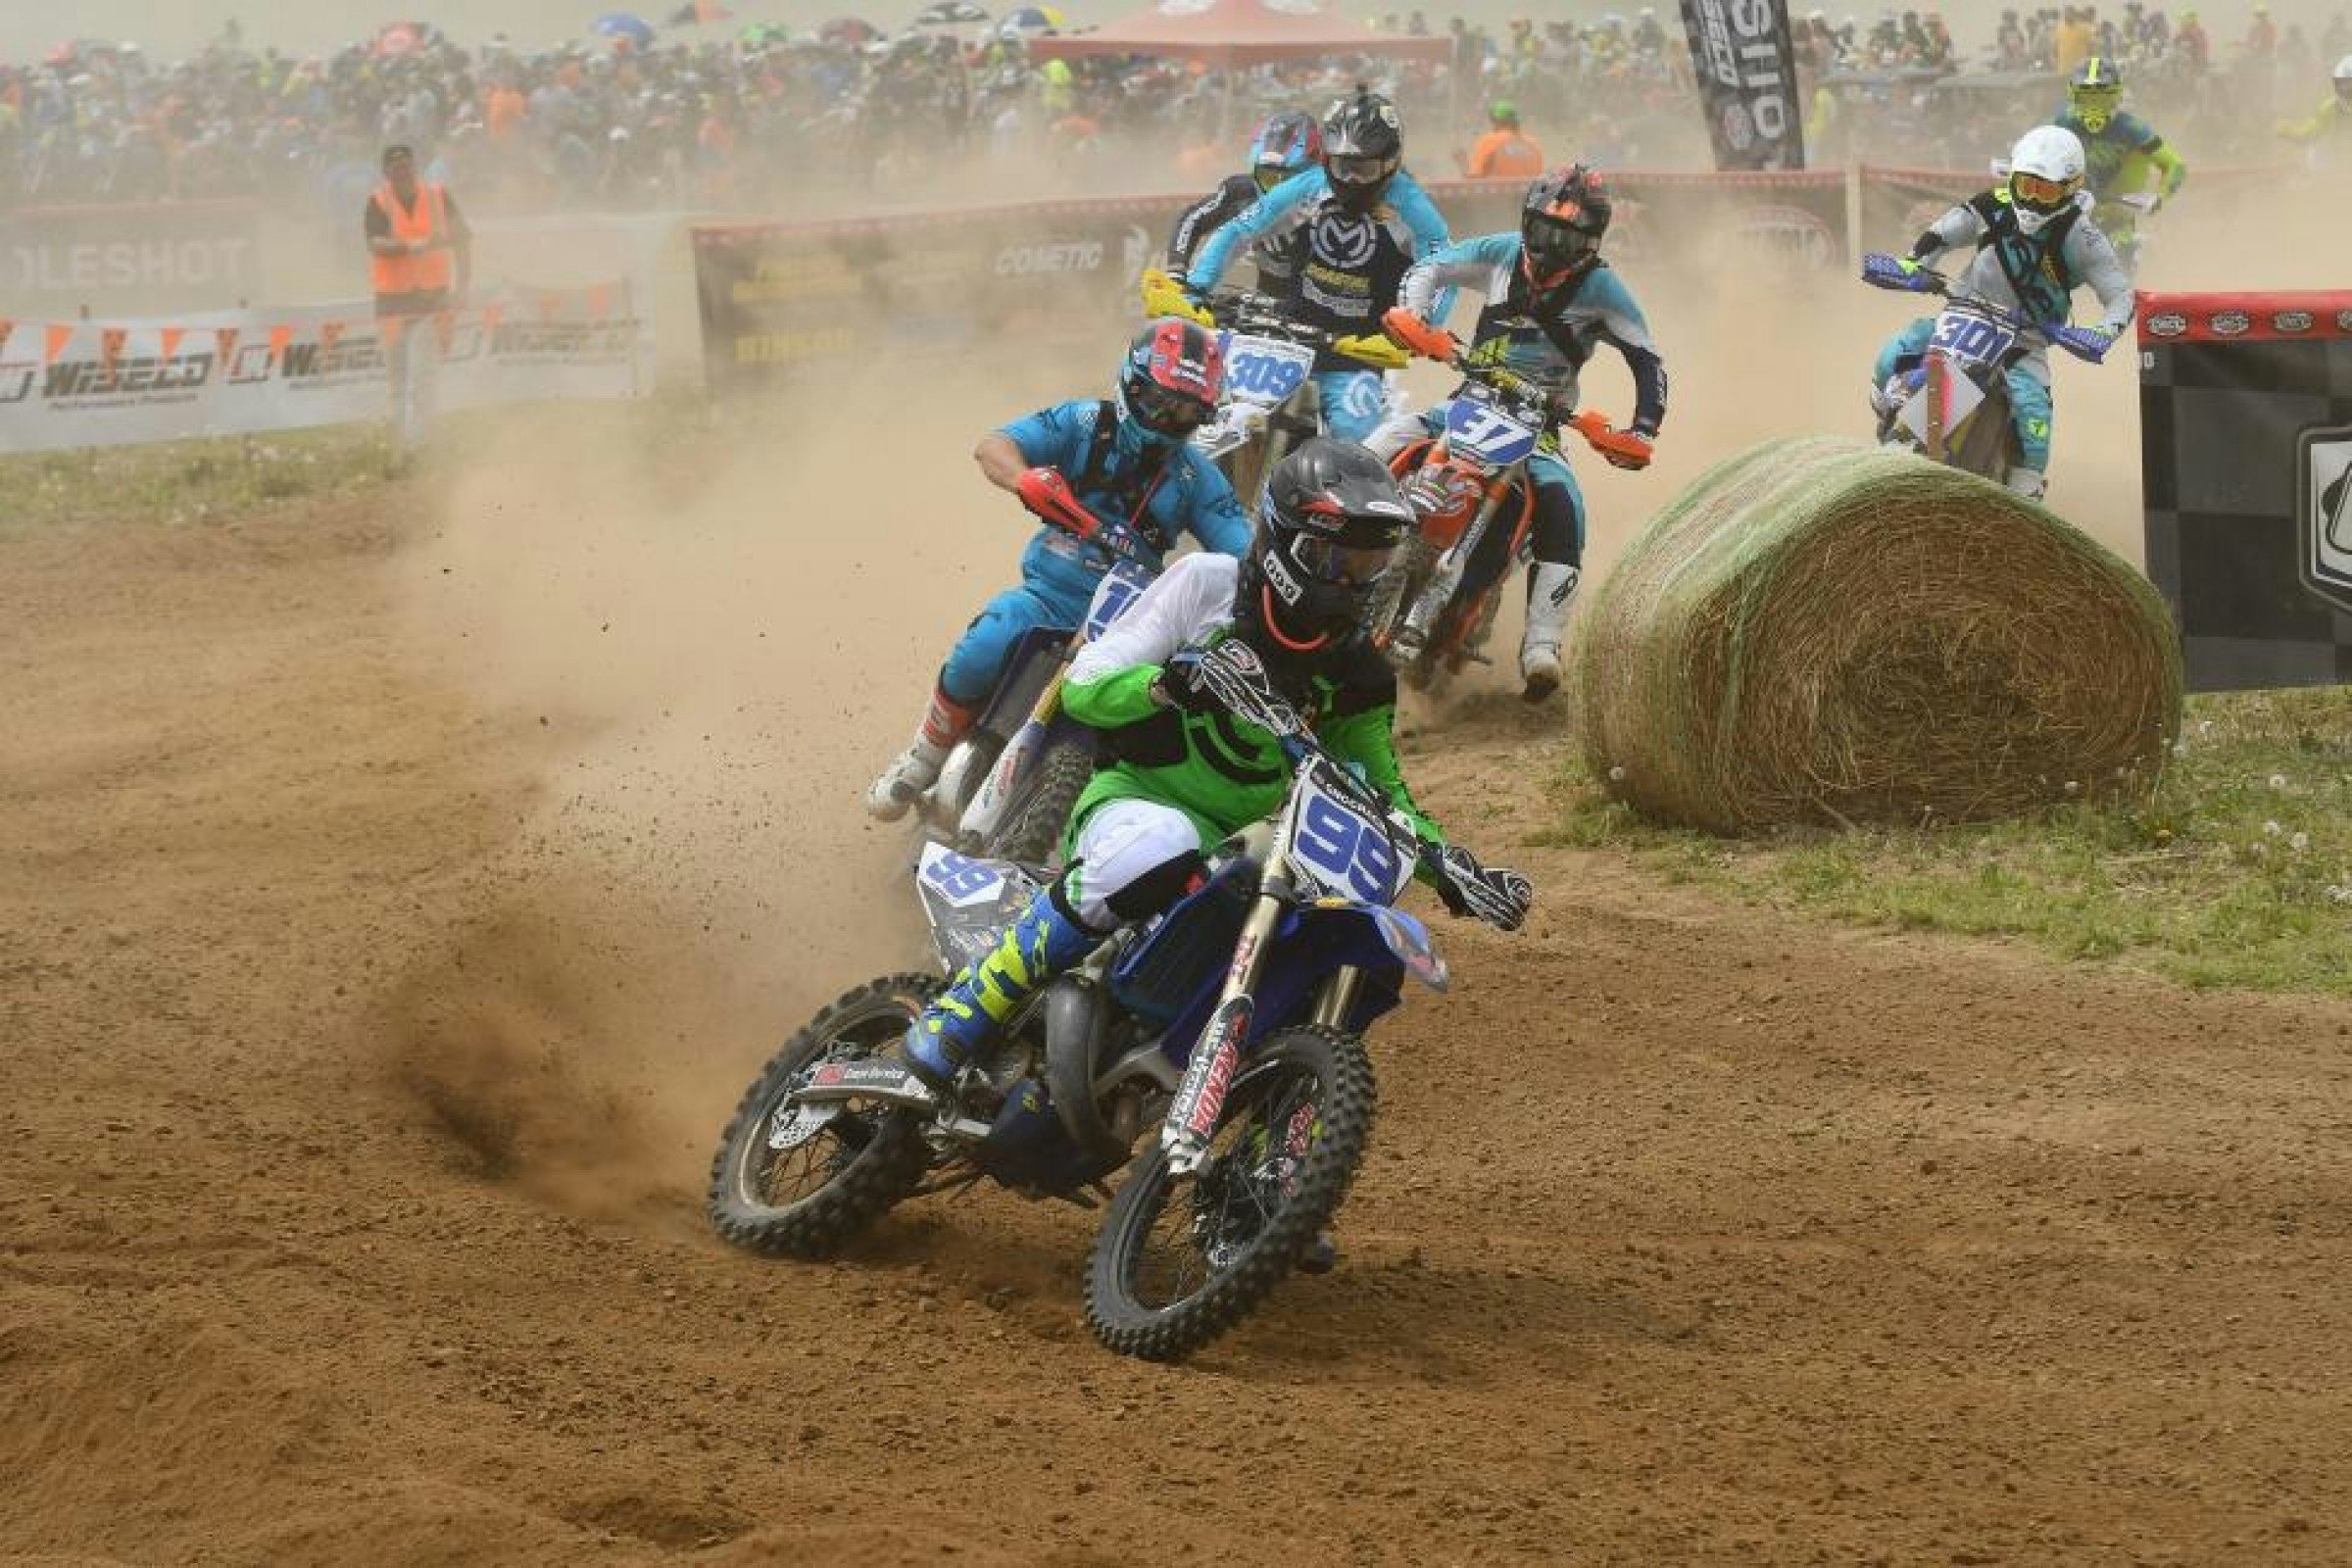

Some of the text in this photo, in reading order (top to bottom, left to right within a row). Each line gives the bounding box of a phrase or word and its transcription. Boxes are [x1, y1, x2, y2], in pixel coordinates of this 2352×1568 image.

[1929, 315, 2010, 365] 301
[1229, 354, 1303, 396] 309
[1448, 396, 1536, 453] 37
[1297, 793, 1402, 906] 99
[925, 852, 1001, 901] 99
[1188, 1040, 1238, 1139] KENDA
